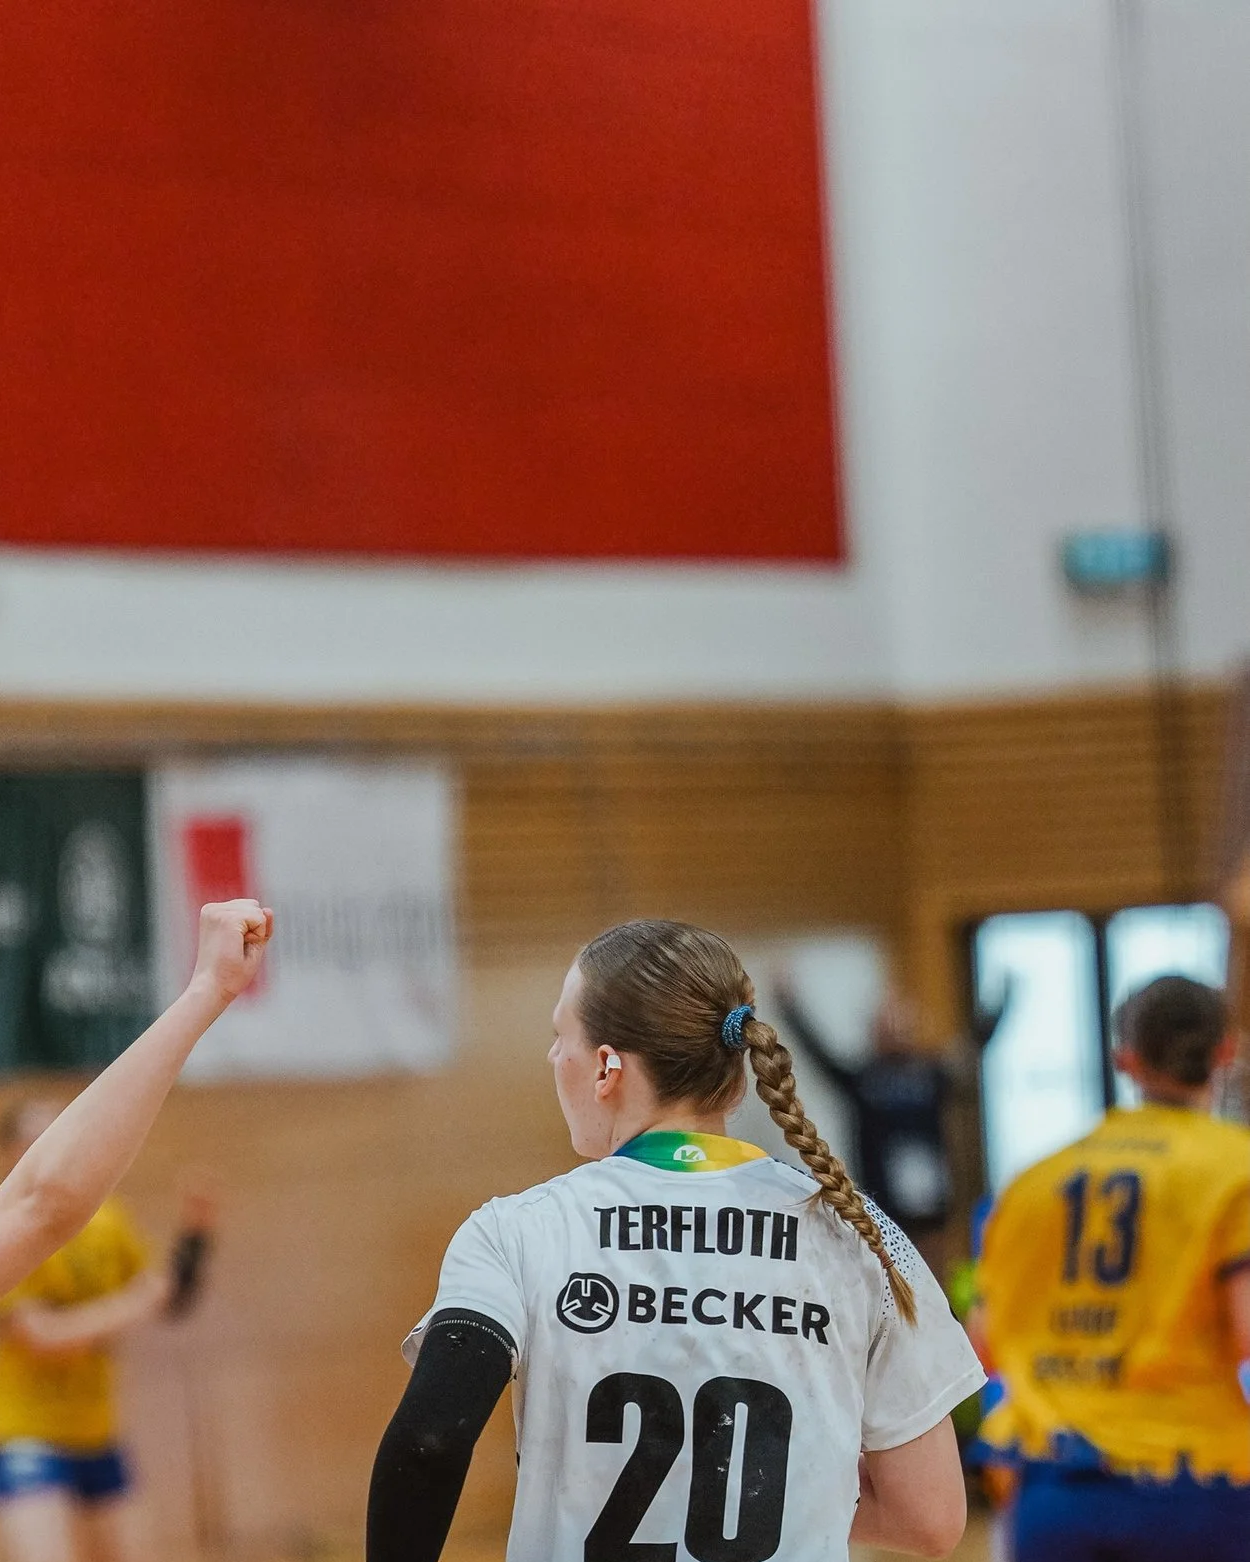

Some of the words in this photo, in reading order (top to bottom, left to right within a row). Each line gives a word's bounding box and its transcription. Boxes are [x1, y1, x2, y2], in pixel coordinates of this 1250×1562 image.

[593, 1204, 799, 1262] TERFLOTH
[1058, 1167, 1143, 1285] 13
[627, 1283, 830, 1346] BECKER
